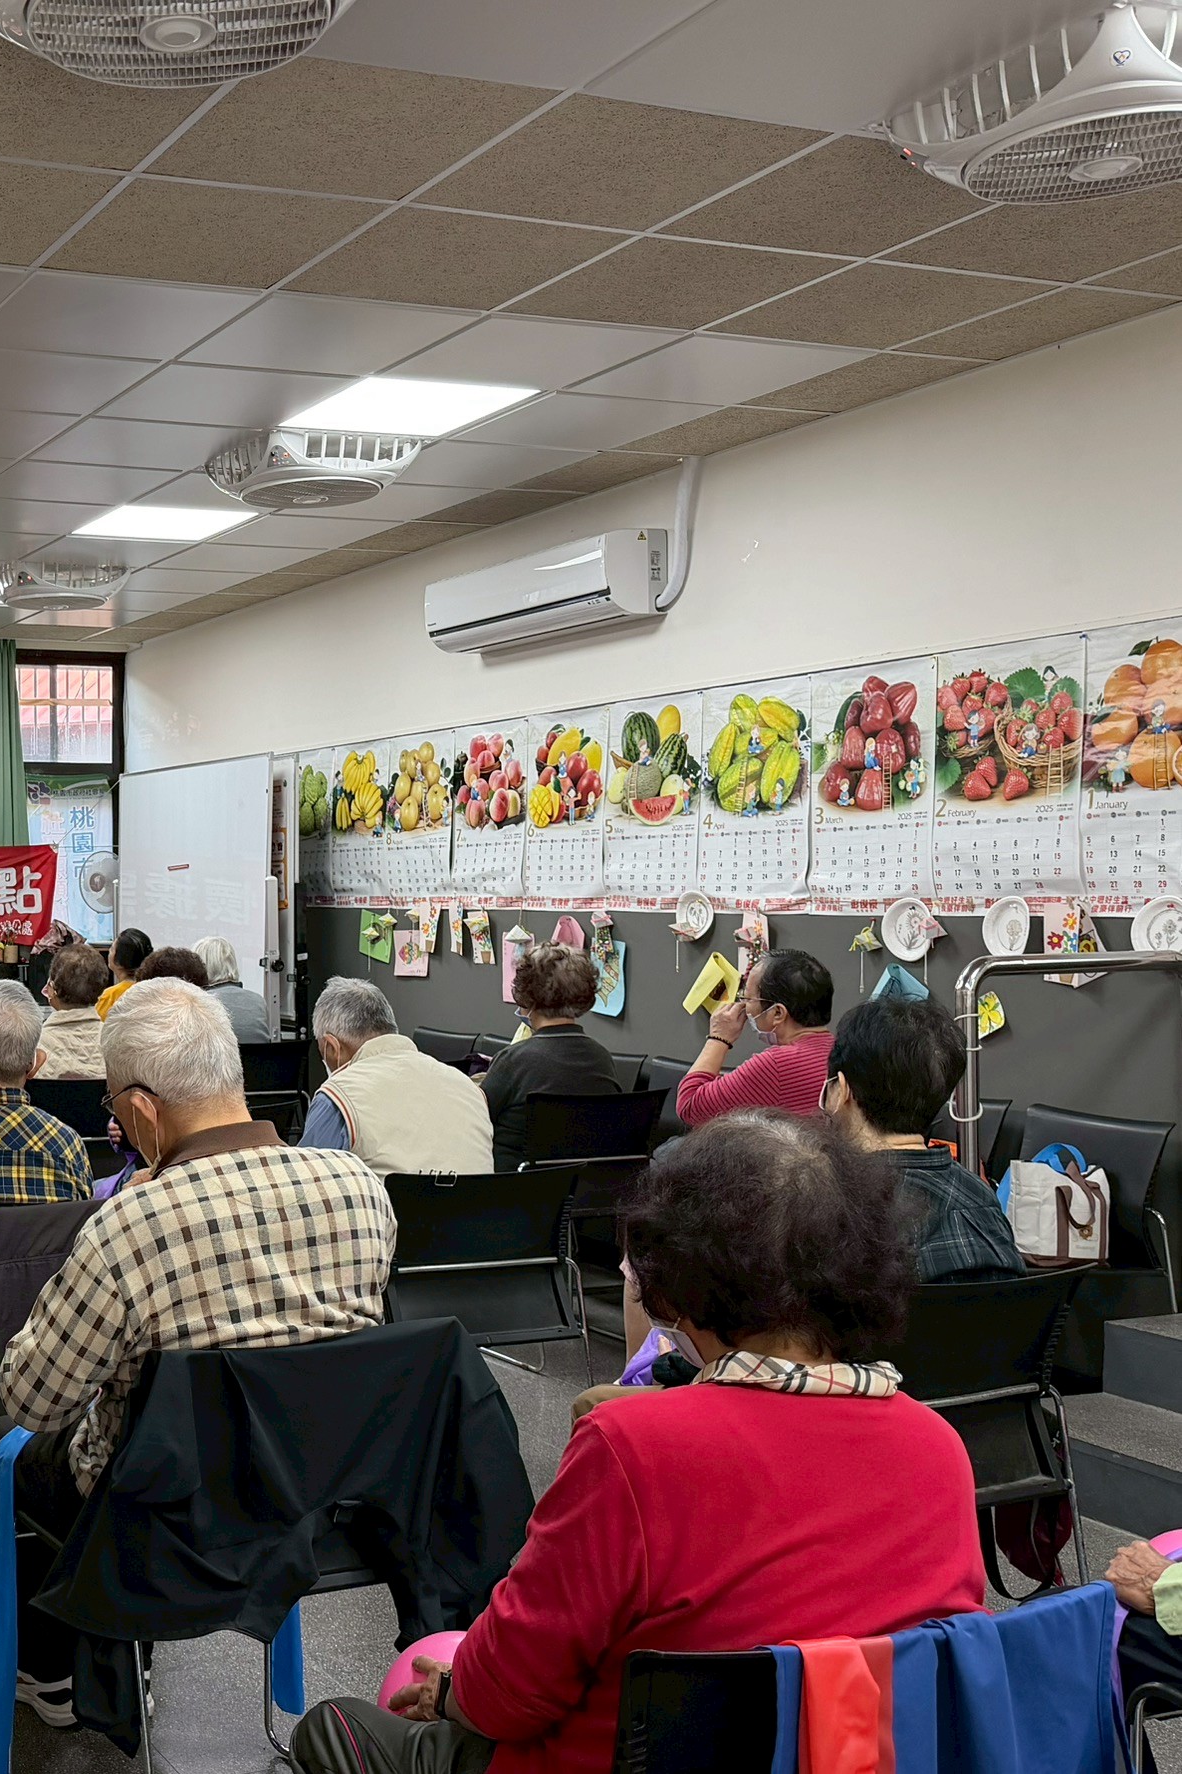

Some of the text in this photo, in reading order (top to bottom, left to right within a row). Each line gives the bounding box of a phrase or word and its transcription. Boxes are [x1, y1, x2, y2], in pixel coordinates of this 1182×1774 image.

[1088, 787, 1094, 810] 1
[1095, 800, 1128, 810] January
[814, 807, 824, 824] 3
[935, 799, 947, 818] 2
[948, 810, 976, 818] February
[1035, 805, 1054, 813] 2025
[606, 819, 613, 833] 5
[703, 814, 713, 829] 4
[456, 829, 461, 841] 7
[528, 824, 534, 837] 6
[69, 806, 96, 878] 桃園市
[386, 833, 391, 844] 8
